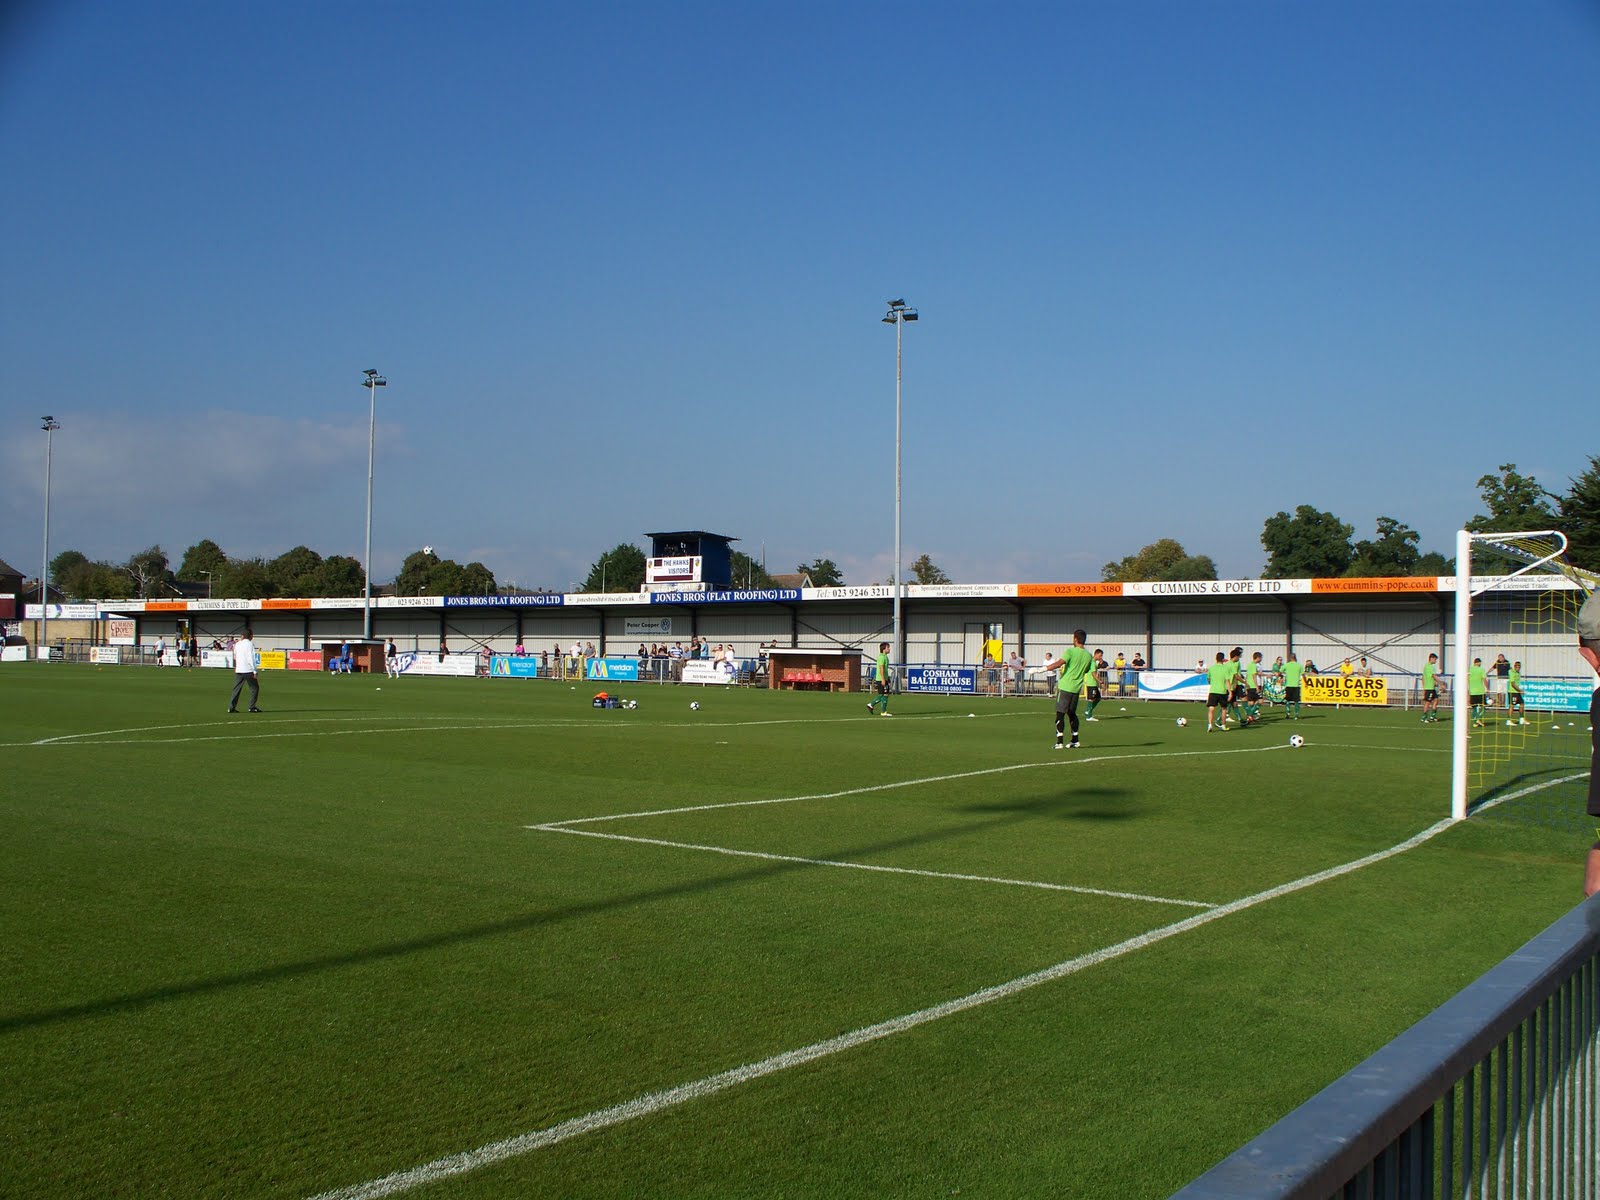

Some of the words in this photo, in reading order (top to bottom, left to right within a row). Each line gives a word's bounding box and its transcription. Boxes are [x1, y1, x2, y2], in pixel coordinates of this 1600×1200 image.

[1152, 582, 1206, 594] CUMMINS
[1211, 583, 1220, 592] &
[1225, 582, 1254, 592] POPE
[1260, 582, 1281, 591] LTD
[1317, 580, 1434, 591] www.cummins-pope.co.uk
[655, 593, 681, 602] JONES
[683, 593, 705, 602] BROS
[707, 592, 732, 602] (FLAT
[734, 590, 777, 600] ROOFING)
[780, 590, 797, 599] LTD
[816, 589, 830, 598] Tel:
[832, 589, 847, 597] 023
[850, 589, 868, 597] 9246
[871, 588, 889, 596] 3211
[447, 597, 468, 605] JONES
[470, 597, 487, 605] BROS
[488, 596, 508, 605] (FLAT
[510, 596, 545, 605] ROOFING)
[546, 596, 560, 604] LTD
[941, 677, 971, 685] HOUSE
[1344, 679, 1384, 689] CARS
[1356, 690, 1378, 698] 350
